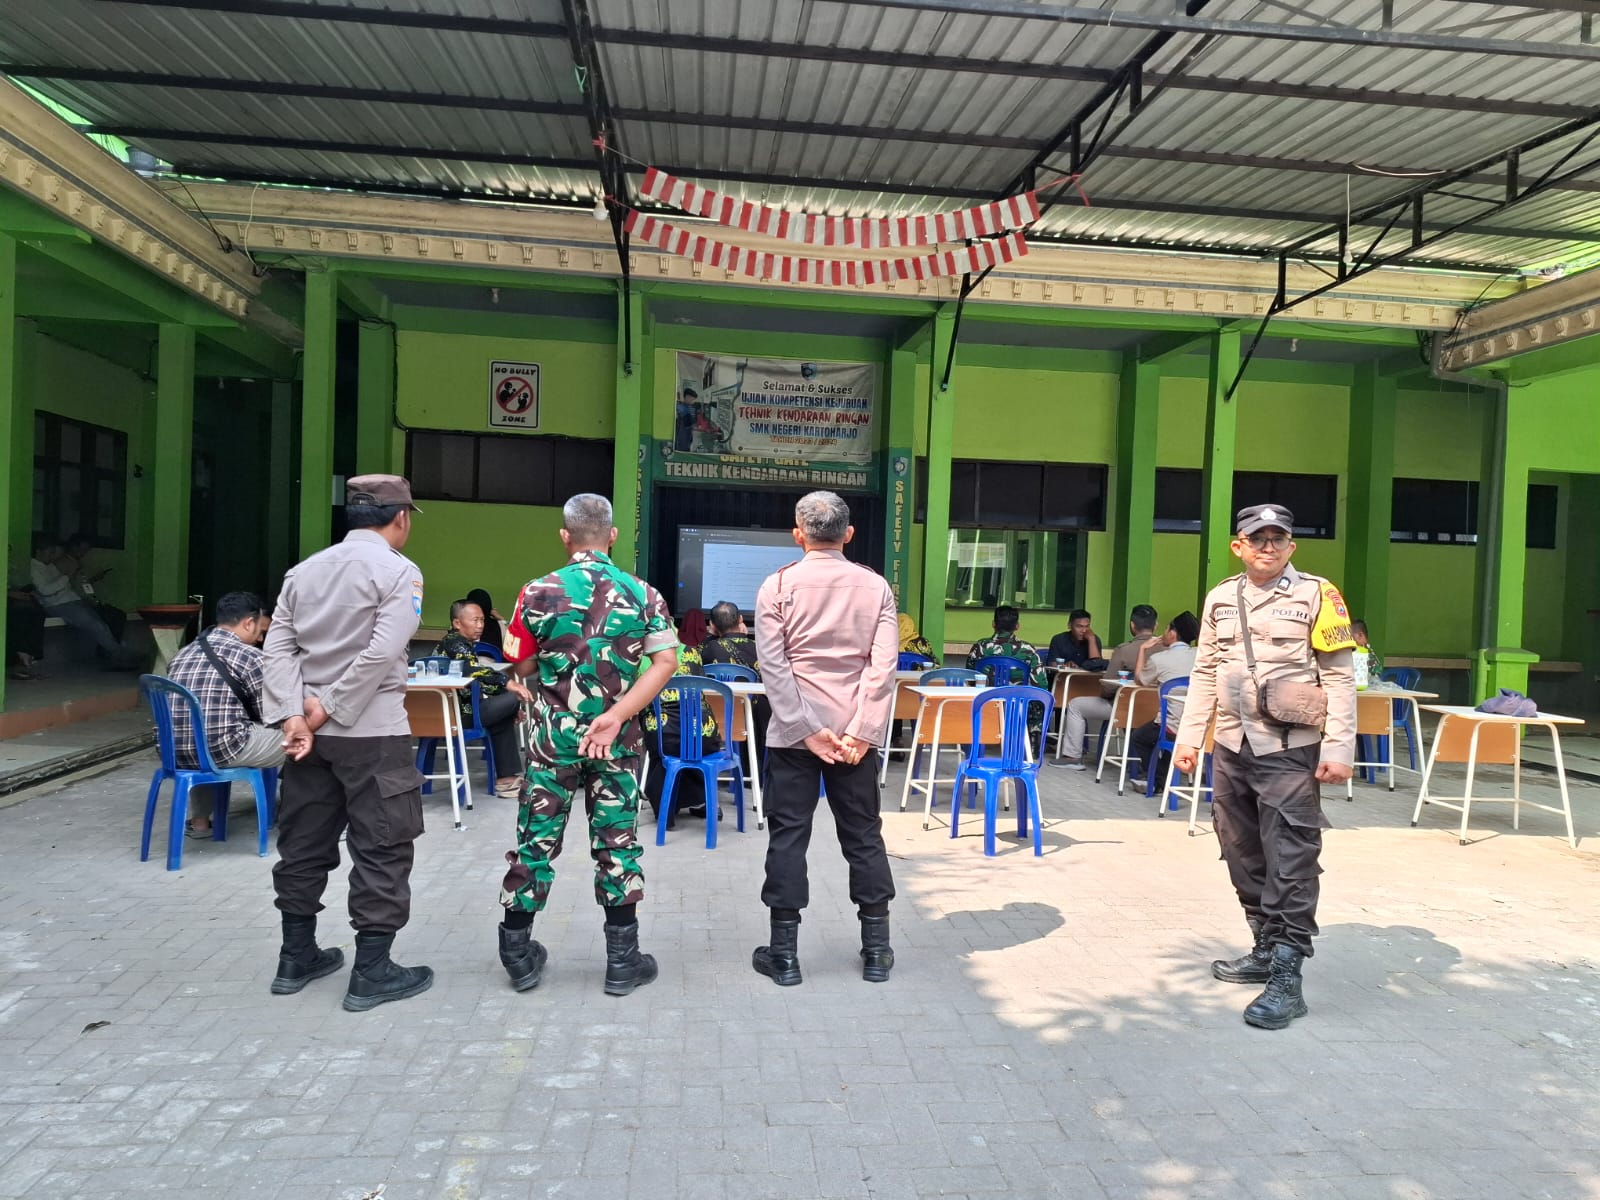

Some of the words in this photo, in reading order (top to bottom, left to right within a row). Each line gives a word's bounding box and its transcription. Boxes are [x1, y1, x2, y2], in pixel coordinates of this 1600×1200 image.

[509, 368, 536, 376] BULLY
[762, 380, 805, 392] Selamat
[807, 383, 816, 392] &
[817, 384, 853, 394] Sukses
[741, 391, 766, 404] UJIAN
[769, 393, 823, 408] KOMPETENSI
[825, 396, 868, 409] KEJURUAN
[502, 415, 526, 423] ZONE
[738, 406, 773, 420] TEHNIK
[776, 408, 832, 422] KENDARAAN
[835, 411, 870, 426] RINGAN
[750, 422, 769, 434] SMK
[771, 423, 801, 436] NEGERI
[803, 425, 858, 440] KARTOHARJO
[664, 461, 719, 478] TEKNIK
[722, 465, 808, 482] KENDARAAN
[811, 470, 867, 486] RINGAN
[893, 480, 904, 553] SAFETY
[1271, 608, 1308, 620] POLRI
